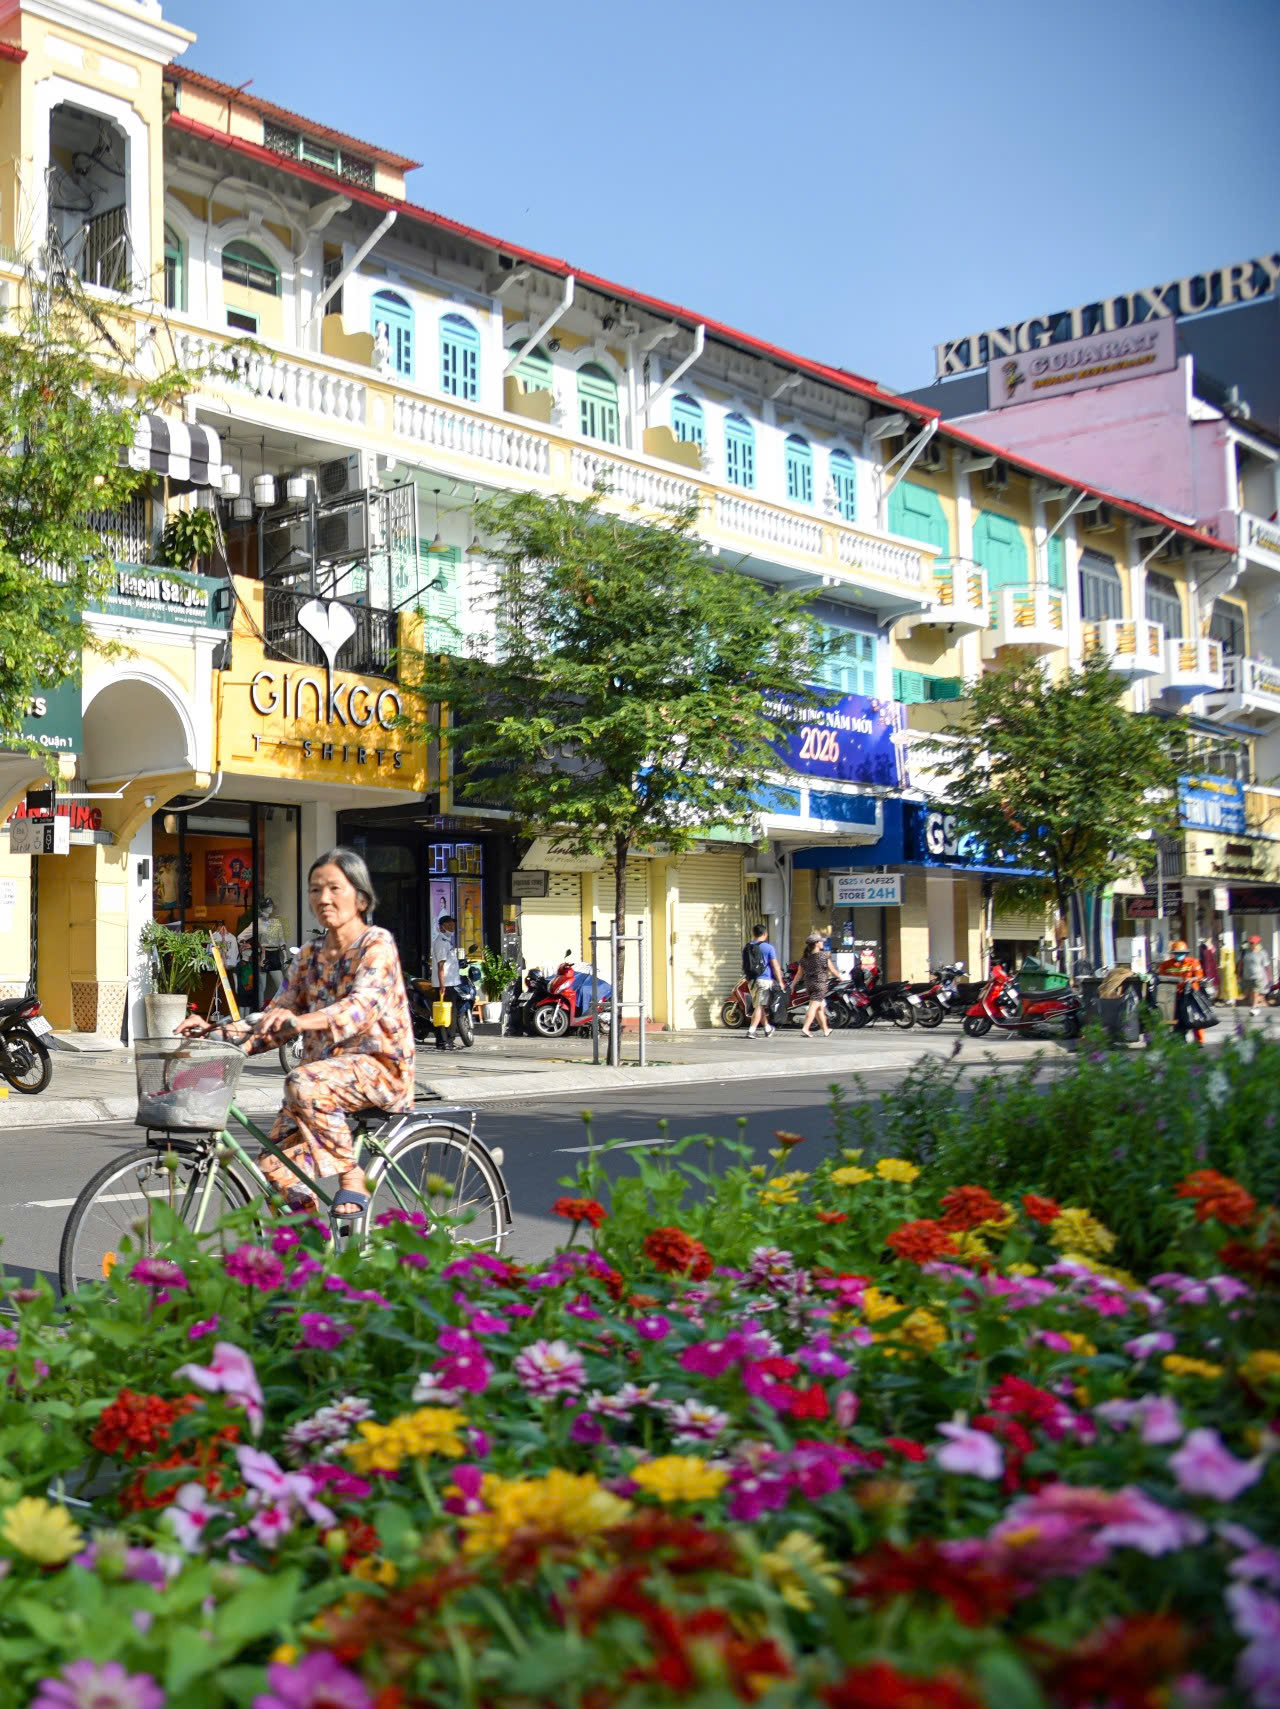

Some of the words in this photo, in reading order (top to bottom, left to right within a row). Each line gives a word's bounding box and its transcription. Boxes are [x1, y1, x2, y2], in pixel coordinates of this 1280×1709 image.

[936, 314, 1055, 379] KING
[1030, 332, 1159, 376] GUJARAT
[826, 710, 851, 731] NĂM
[799, 726, 840, 763] 2026
[838, 878, 858, 886] GS25
[839, 892, 866, 900] STORE
[867, 887, 896, 899] 24H
